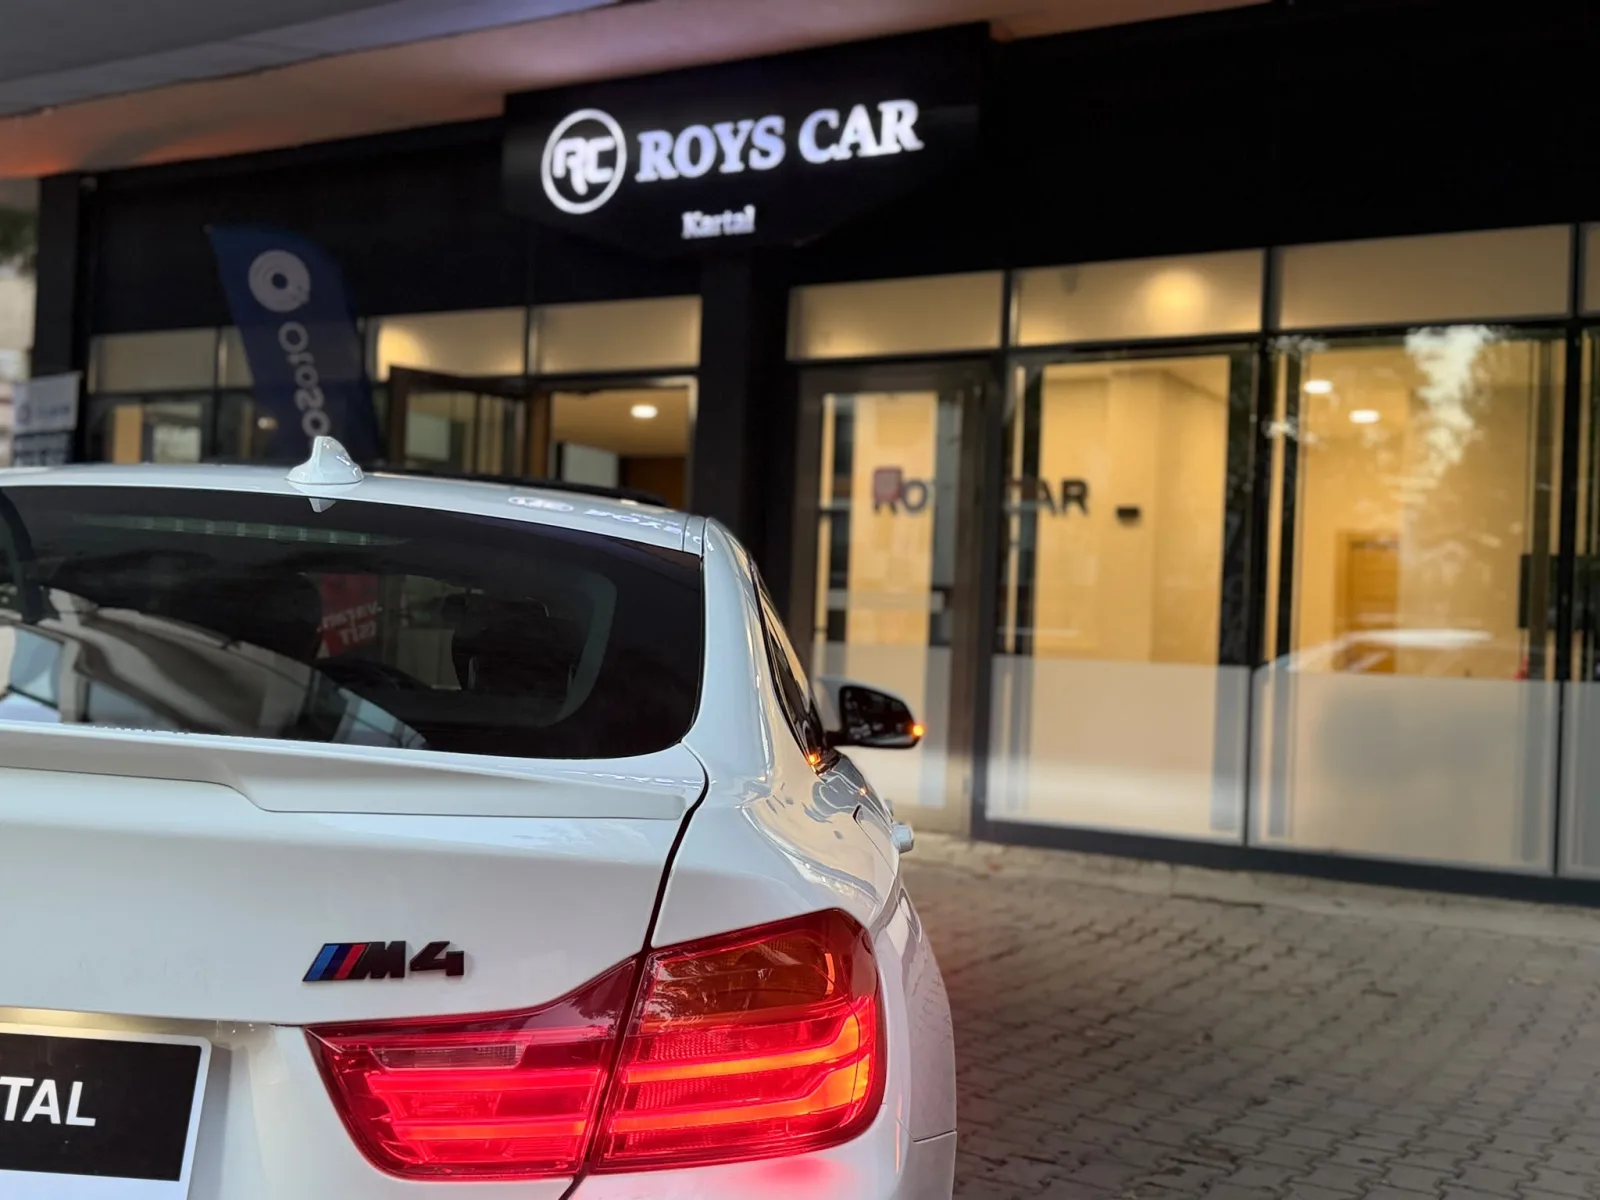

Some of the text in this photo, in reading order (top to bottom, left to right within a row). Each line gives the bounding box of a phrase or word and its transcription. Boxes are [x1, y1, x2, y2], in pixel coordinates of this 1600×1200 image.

[635, 99, 924, 182] ROYS CAR
[681, 204, 756, 239] Kartal
[346, 940, 464, 979] M4
[0, 1076, 96, 1126] TAL
